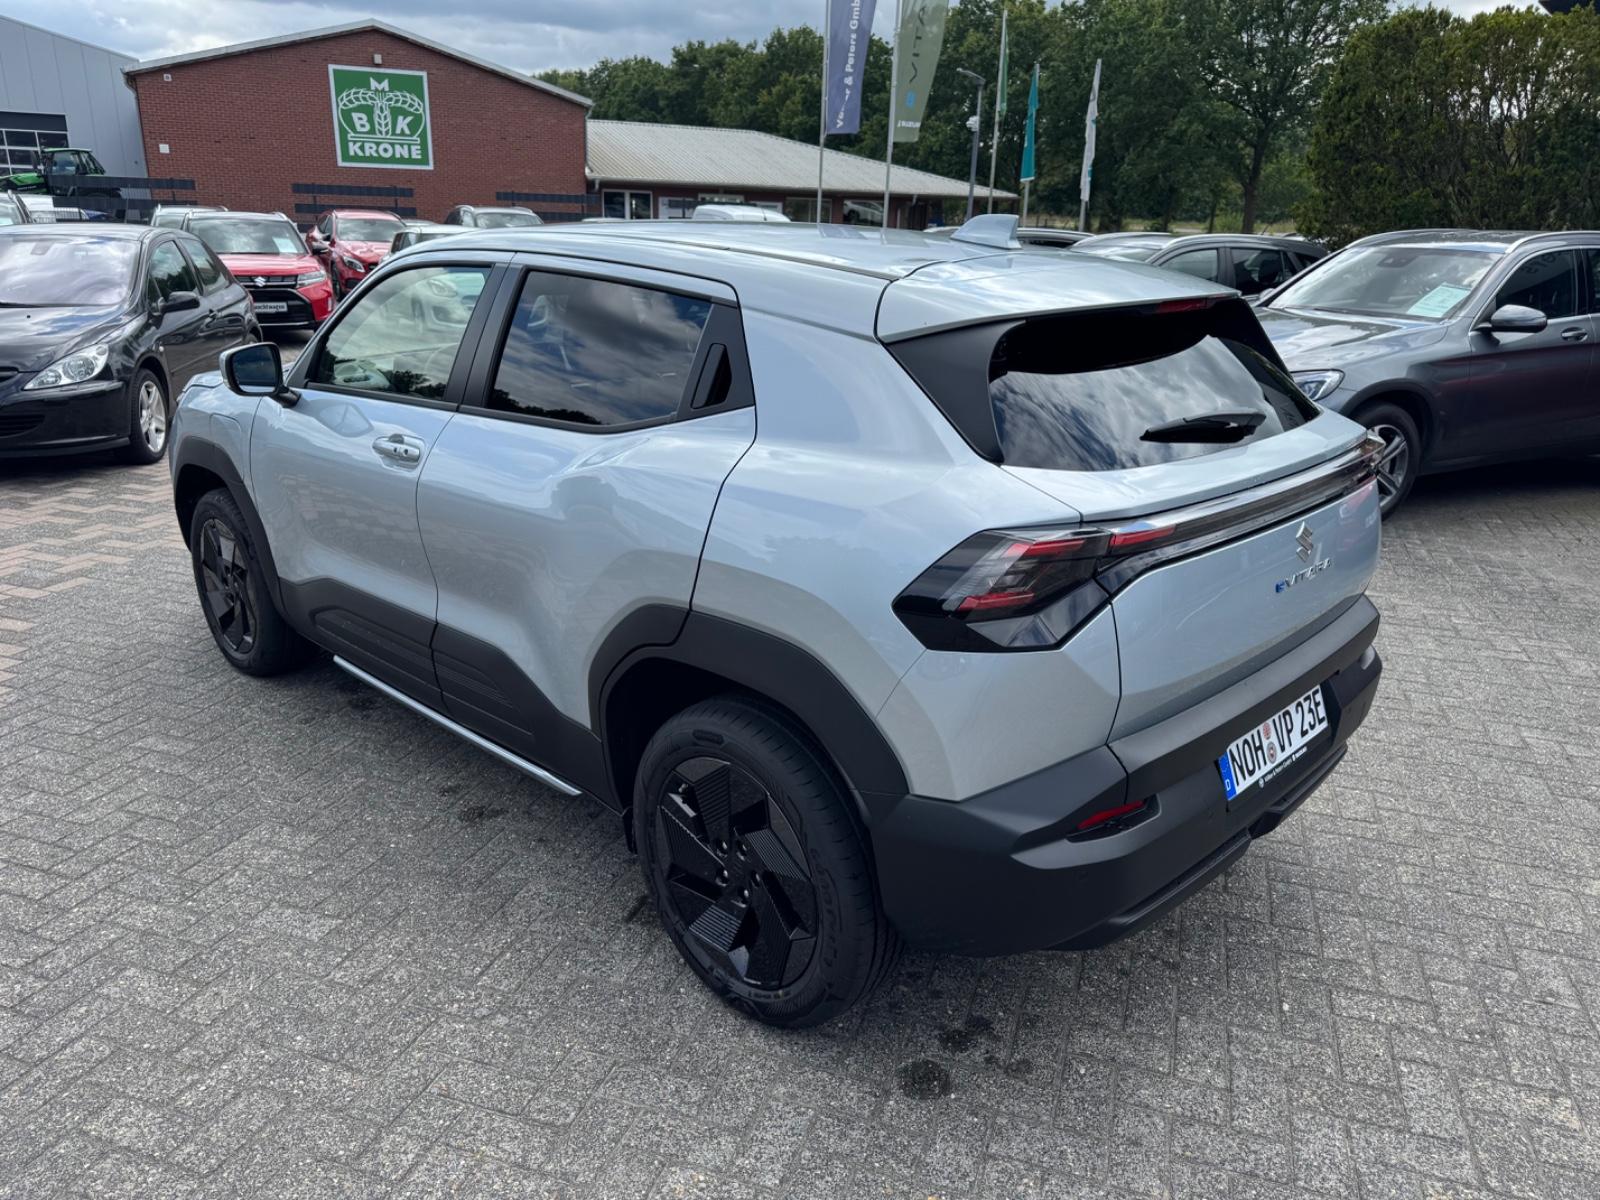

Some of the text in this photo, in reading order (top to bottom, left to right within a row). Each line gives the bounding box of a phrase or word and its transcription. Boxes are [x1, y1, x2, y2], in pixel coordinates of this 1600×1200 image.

[844, 76, 853, 86] &
[849, 0, 860, 30] Gmb
[370, 77, 390, 92] M
[351, 112, 414, 135] B K
[348, 141, 422, 159] KRONE
[1225, 779, 1232, 791] D
[1229, 729, 1267, 786] NOH
[1272, 709, 1294, 753] VP
[1295, 688, 1326, 739] 23E
